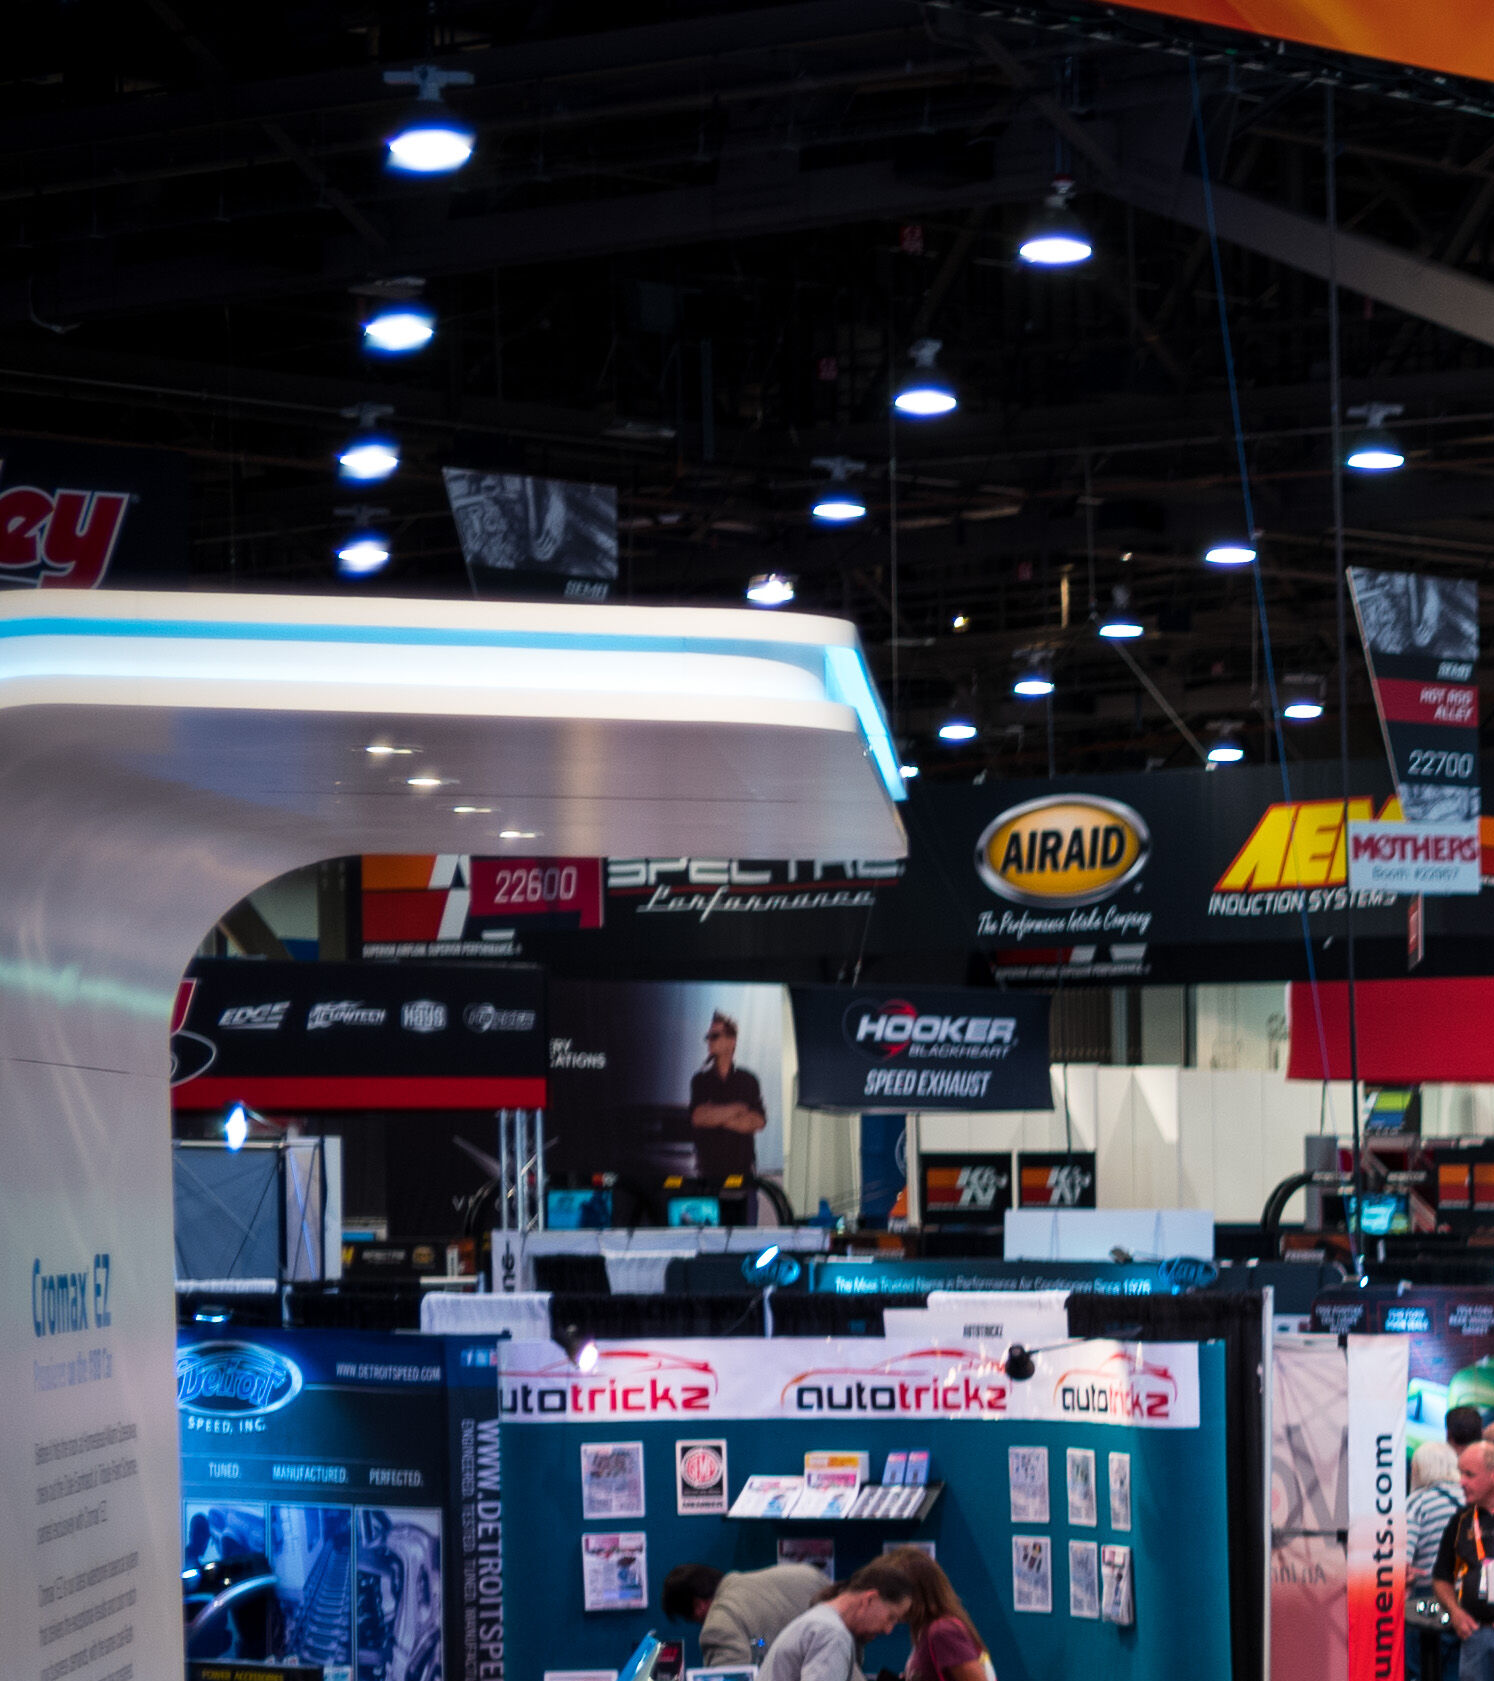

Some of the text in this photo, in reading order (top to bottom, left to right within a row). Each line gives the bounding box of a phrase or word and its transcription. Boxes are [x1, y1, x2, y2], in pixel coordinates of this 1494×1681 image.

[1407, 750, 1475, 778] 22700
[1000, 826, 1127, 875] AIRAID
[1351, 832, 1481, 863] MOTHERS
[494, 866, 578, 905] 22600
[1208, 890, 1302, 917] INDUCTION
[856, 1014, 1017, 1043] HOOKER
[908, 1043, 1010, 1060] BLACKHEART
[864, 1069, 992, 1098] SPEED EXHAUST
[32, 1253, 112, 1338] Cromax EZ
[501, 1378, 710, 1415] utotrickz
[796, 1377, 1008, 1414] autotrickz
[1060, 1385, 1170, 1420] autotrickz
[208, 1462, 241, 1480] TUNED.
[272, 1463, 349, 1484] MANUFACTURED.
